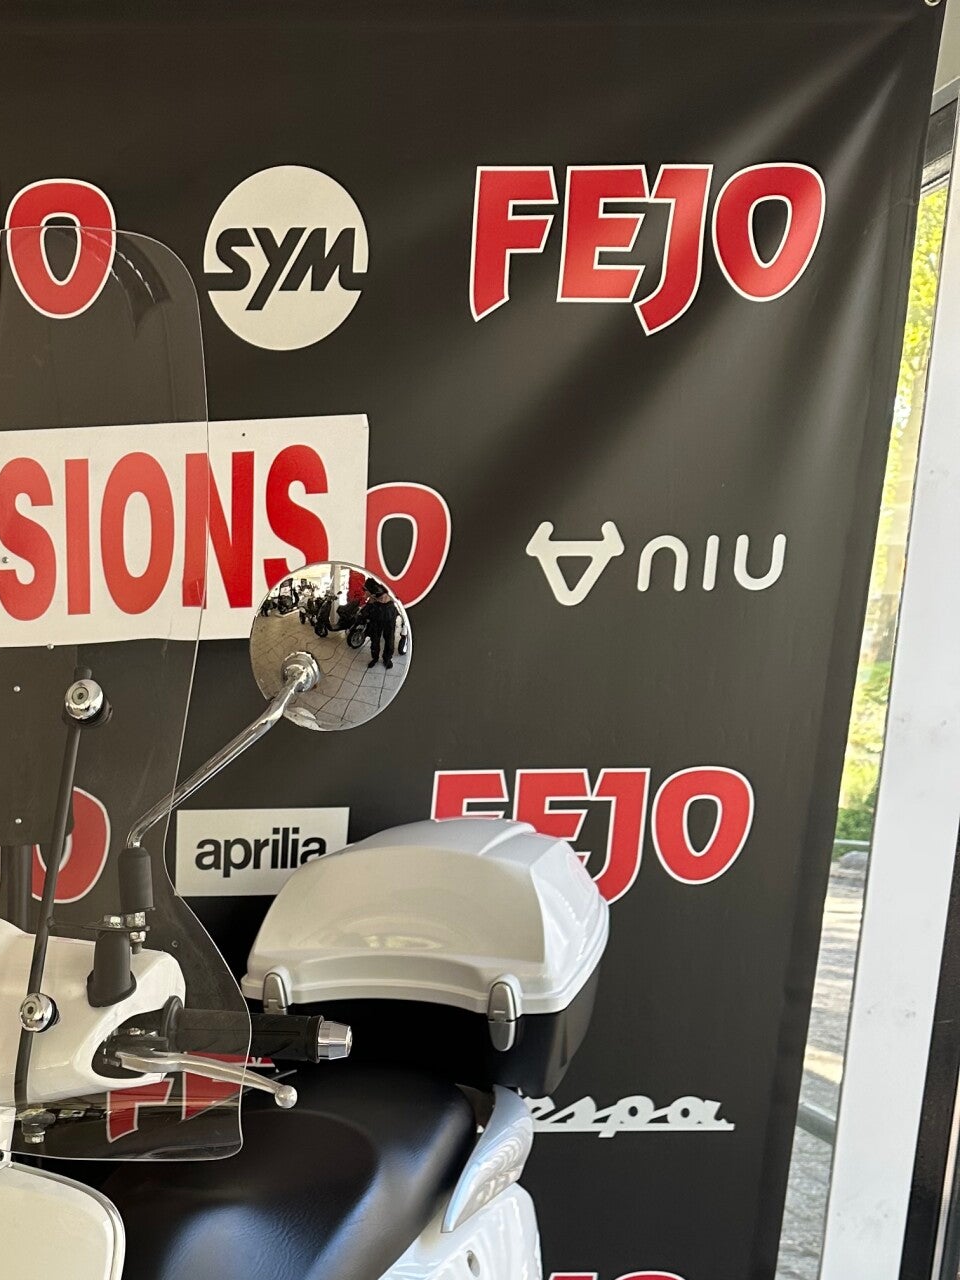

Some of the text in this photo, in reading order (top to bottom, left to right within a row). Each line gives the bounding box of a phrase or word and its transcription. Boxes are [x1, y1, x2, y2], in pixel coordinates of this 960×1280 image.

[204, 226, 369, 311] SYM
[469, 162, 826, 336] FEJO
[194, 827, 327, 878] aprilia
[520, 1095, 735, 1138] espa
